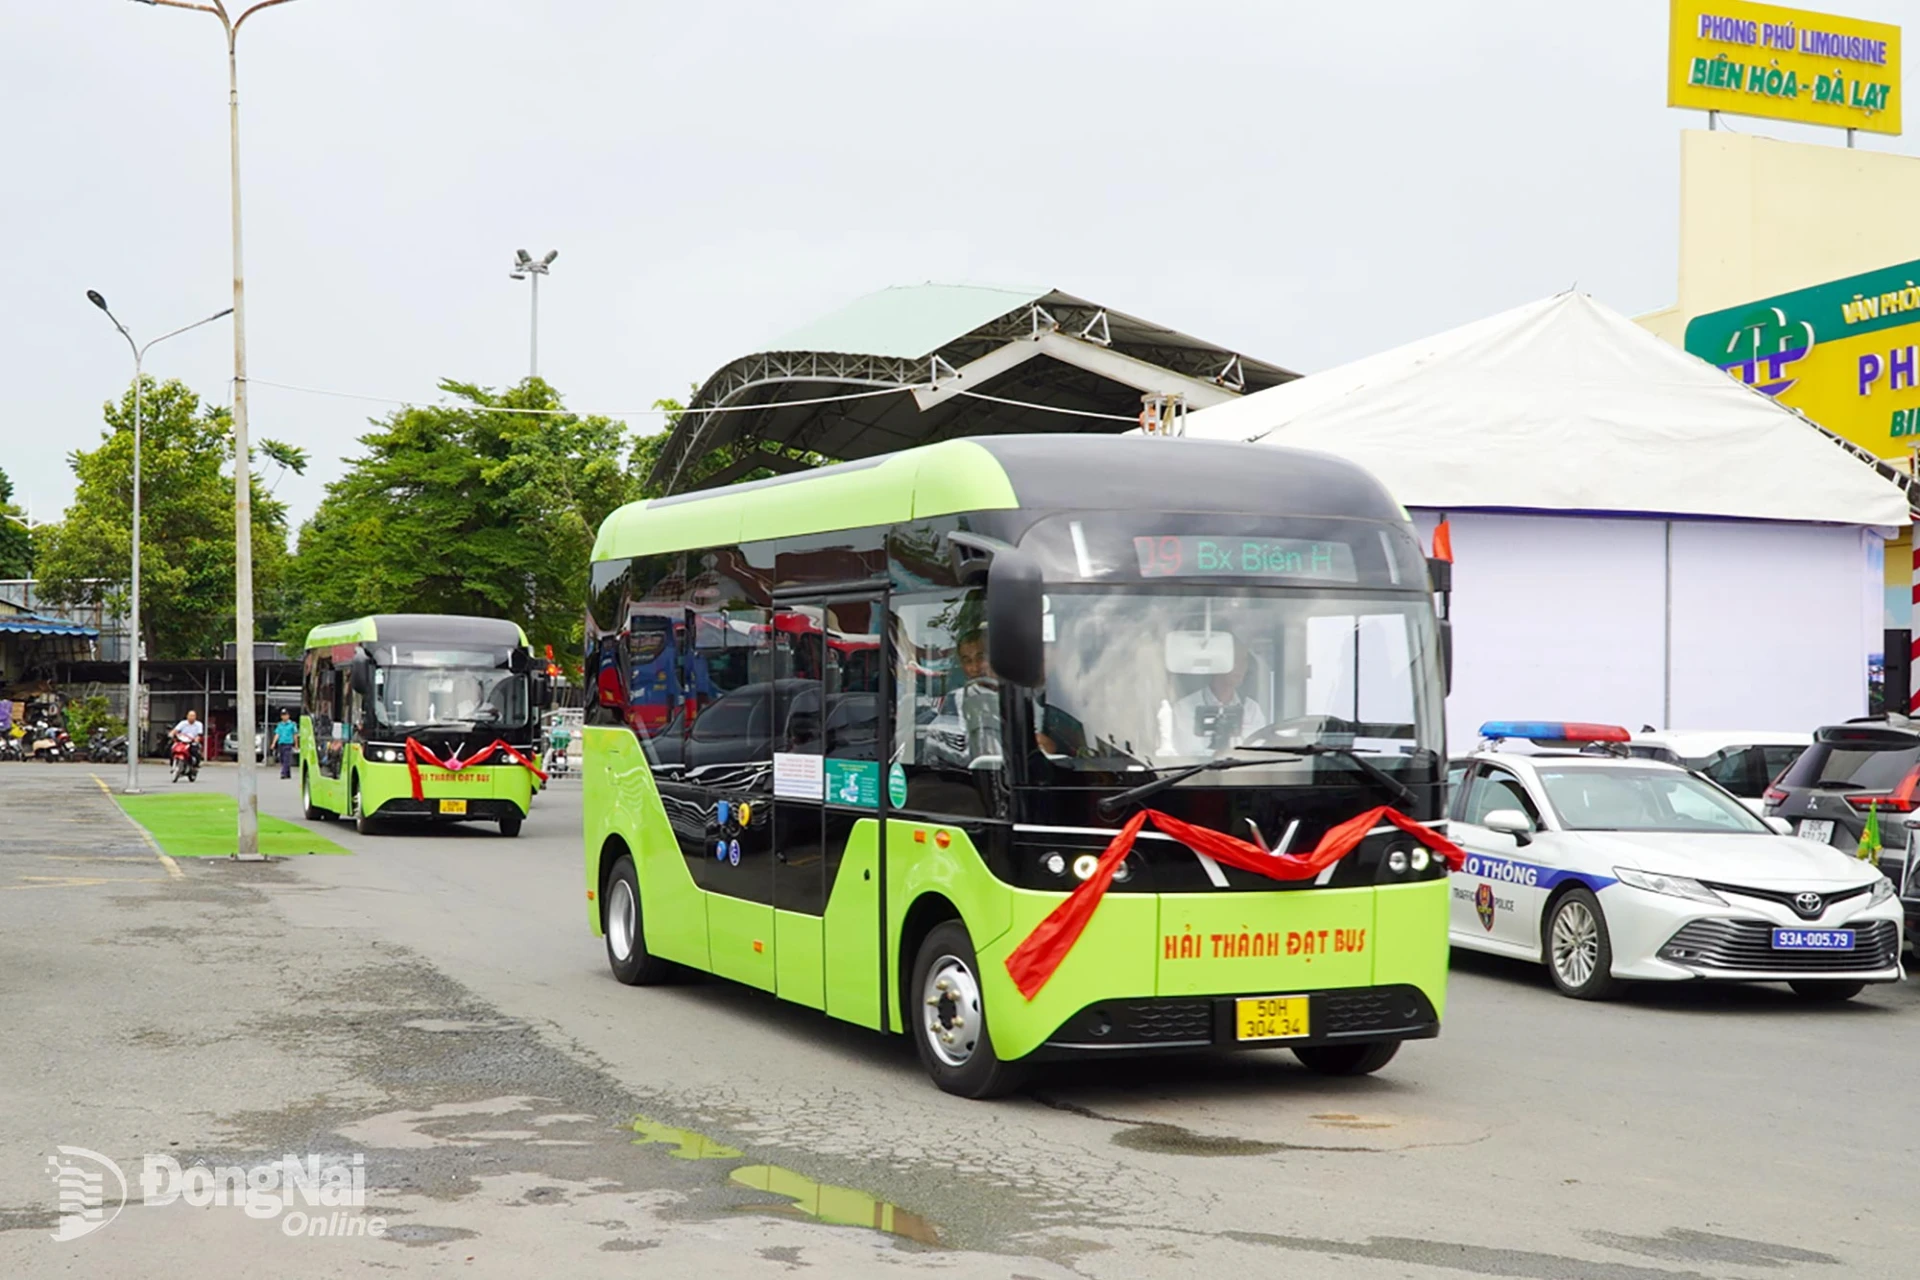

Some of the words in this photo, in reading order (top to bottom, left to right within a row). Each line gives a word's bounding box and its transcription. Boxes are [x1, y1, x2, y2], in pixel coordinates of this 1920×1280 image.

[1699, 14, 1757, 46] PHONG
[1761, 21, 1796, 51] PHÚ
[1799, 29, 1887, 65] LIMOUSINE
[1689, 52, 1744, 90] BIÊN
[1849, 80, 1891, 116] LẠT
[1841, 294, 1879, 325] VĂN
[1197, 541, 1234, 572] Bx
[1241, 542, 1303, 573] Biên
[1310, 543, 1333, 573] H
[1482, 860, 1537, 886] THÔNG
[1164, 923, 1202, 960] HẢI
[1210, 924, 1280, 959] THÀNH
[1286, 930, 1329, 963] ĐẠT
[1334, 928, 1366, 953] BUS
[1257, 999, 1288, 1018] 50H
[1246, 1018, 1300, 1038] 304.34
